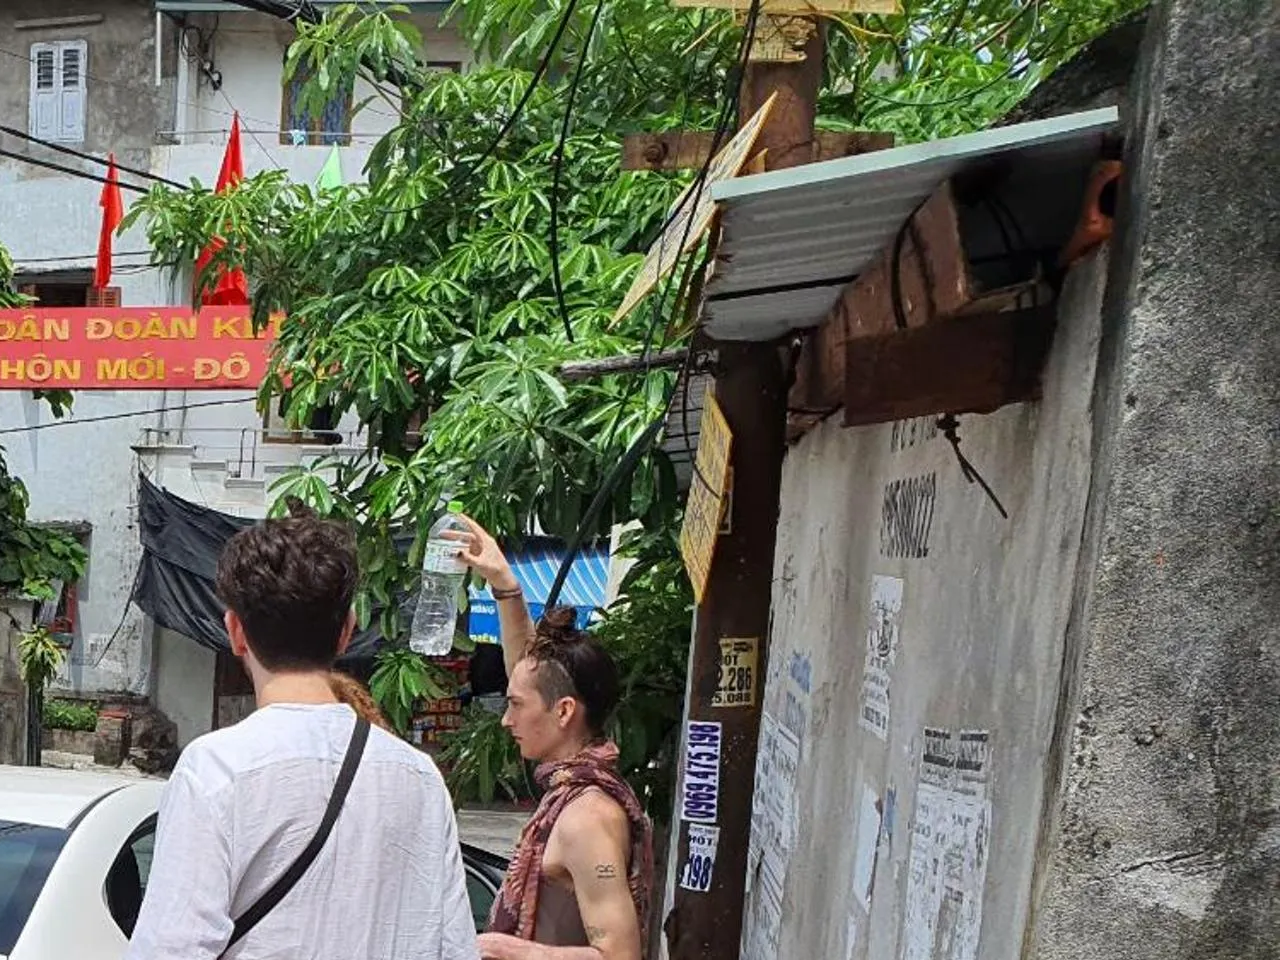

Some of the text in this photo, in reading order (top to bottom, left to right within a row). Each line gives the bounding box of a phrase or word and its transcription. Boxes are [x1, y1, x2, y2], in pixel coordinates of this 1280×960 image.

[86, 312, 197, 340] ĐOÀN
[192, 352, 250, 380] ĐÔ
[684, 724, 720, 818] 0969.475.198
